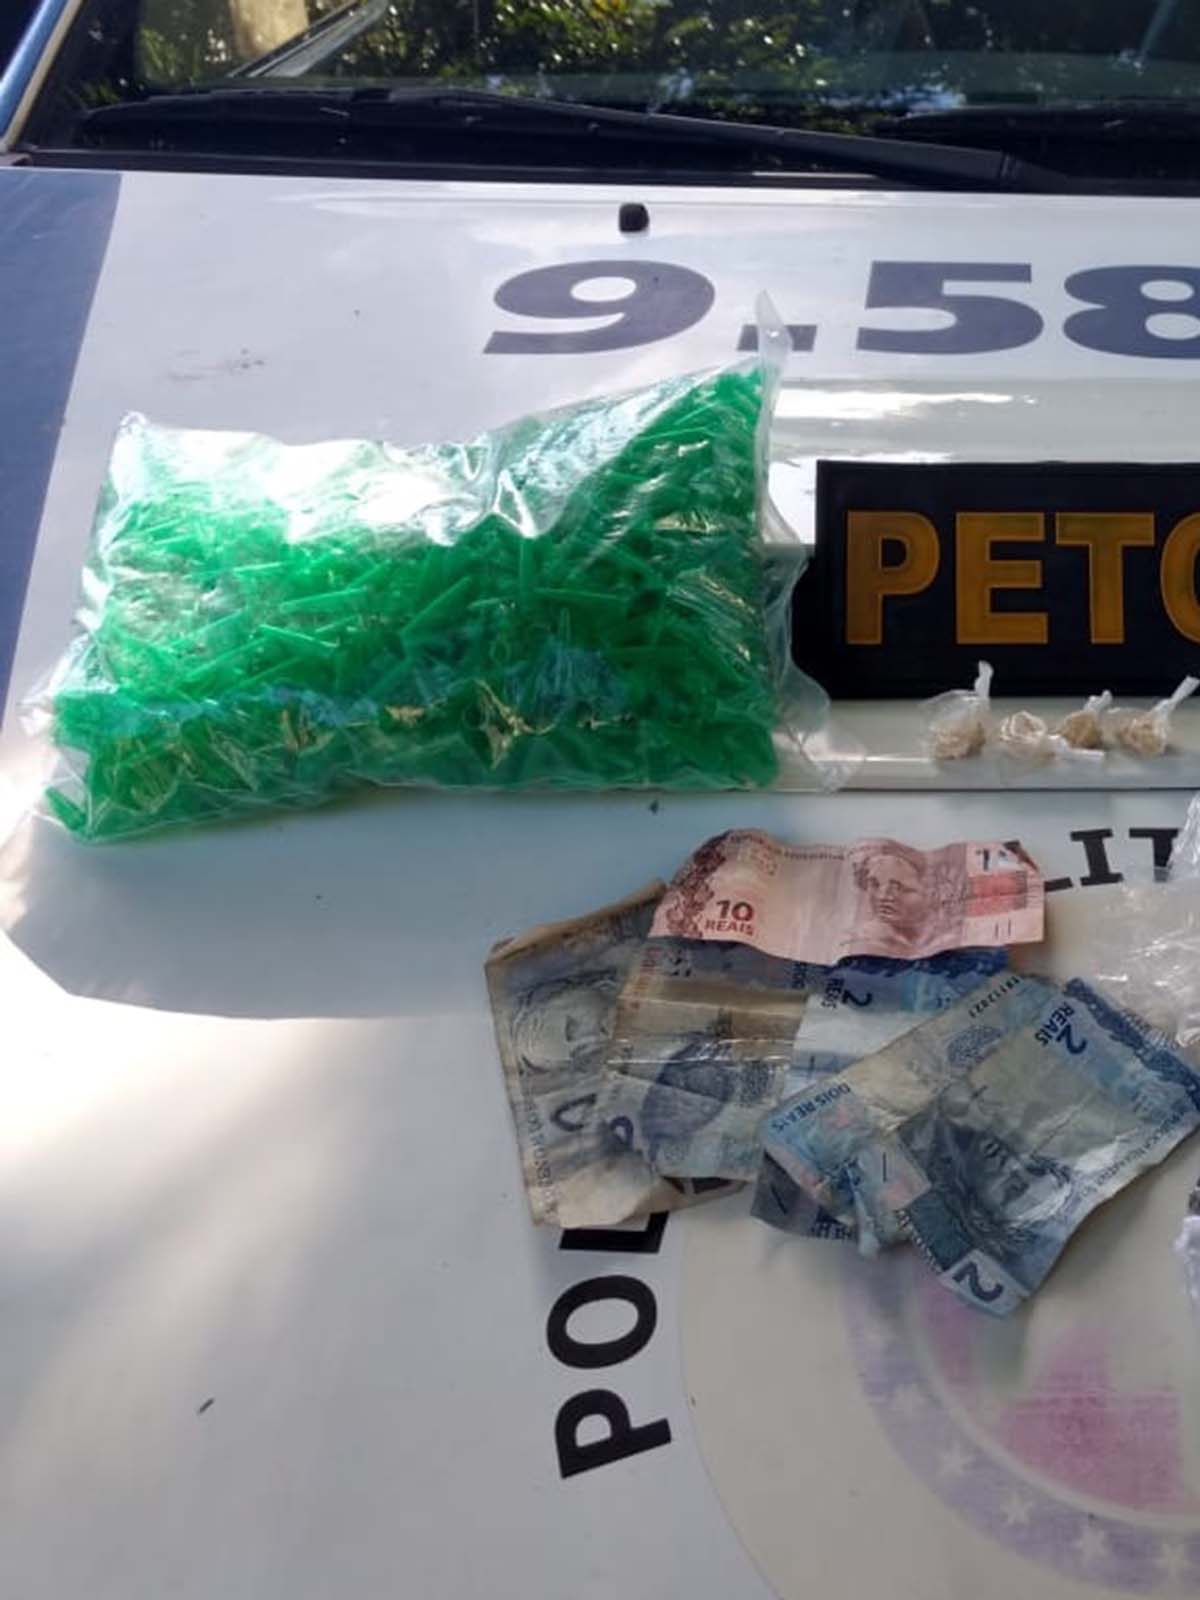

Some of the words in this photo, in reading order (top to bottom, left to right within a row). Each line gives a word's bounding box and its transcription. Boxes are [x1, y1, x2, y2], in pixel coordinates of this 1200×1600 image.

[716, 899, 755, 922] 10
[705, 919, 755, 937] REAIS
[841, 989, 873, 1008] 2
[1034, 1001, 1075, 1047] REAIS
[1056, 1023, 1088, 1055] 2
[952, 1260, 1004, 1301] 2
